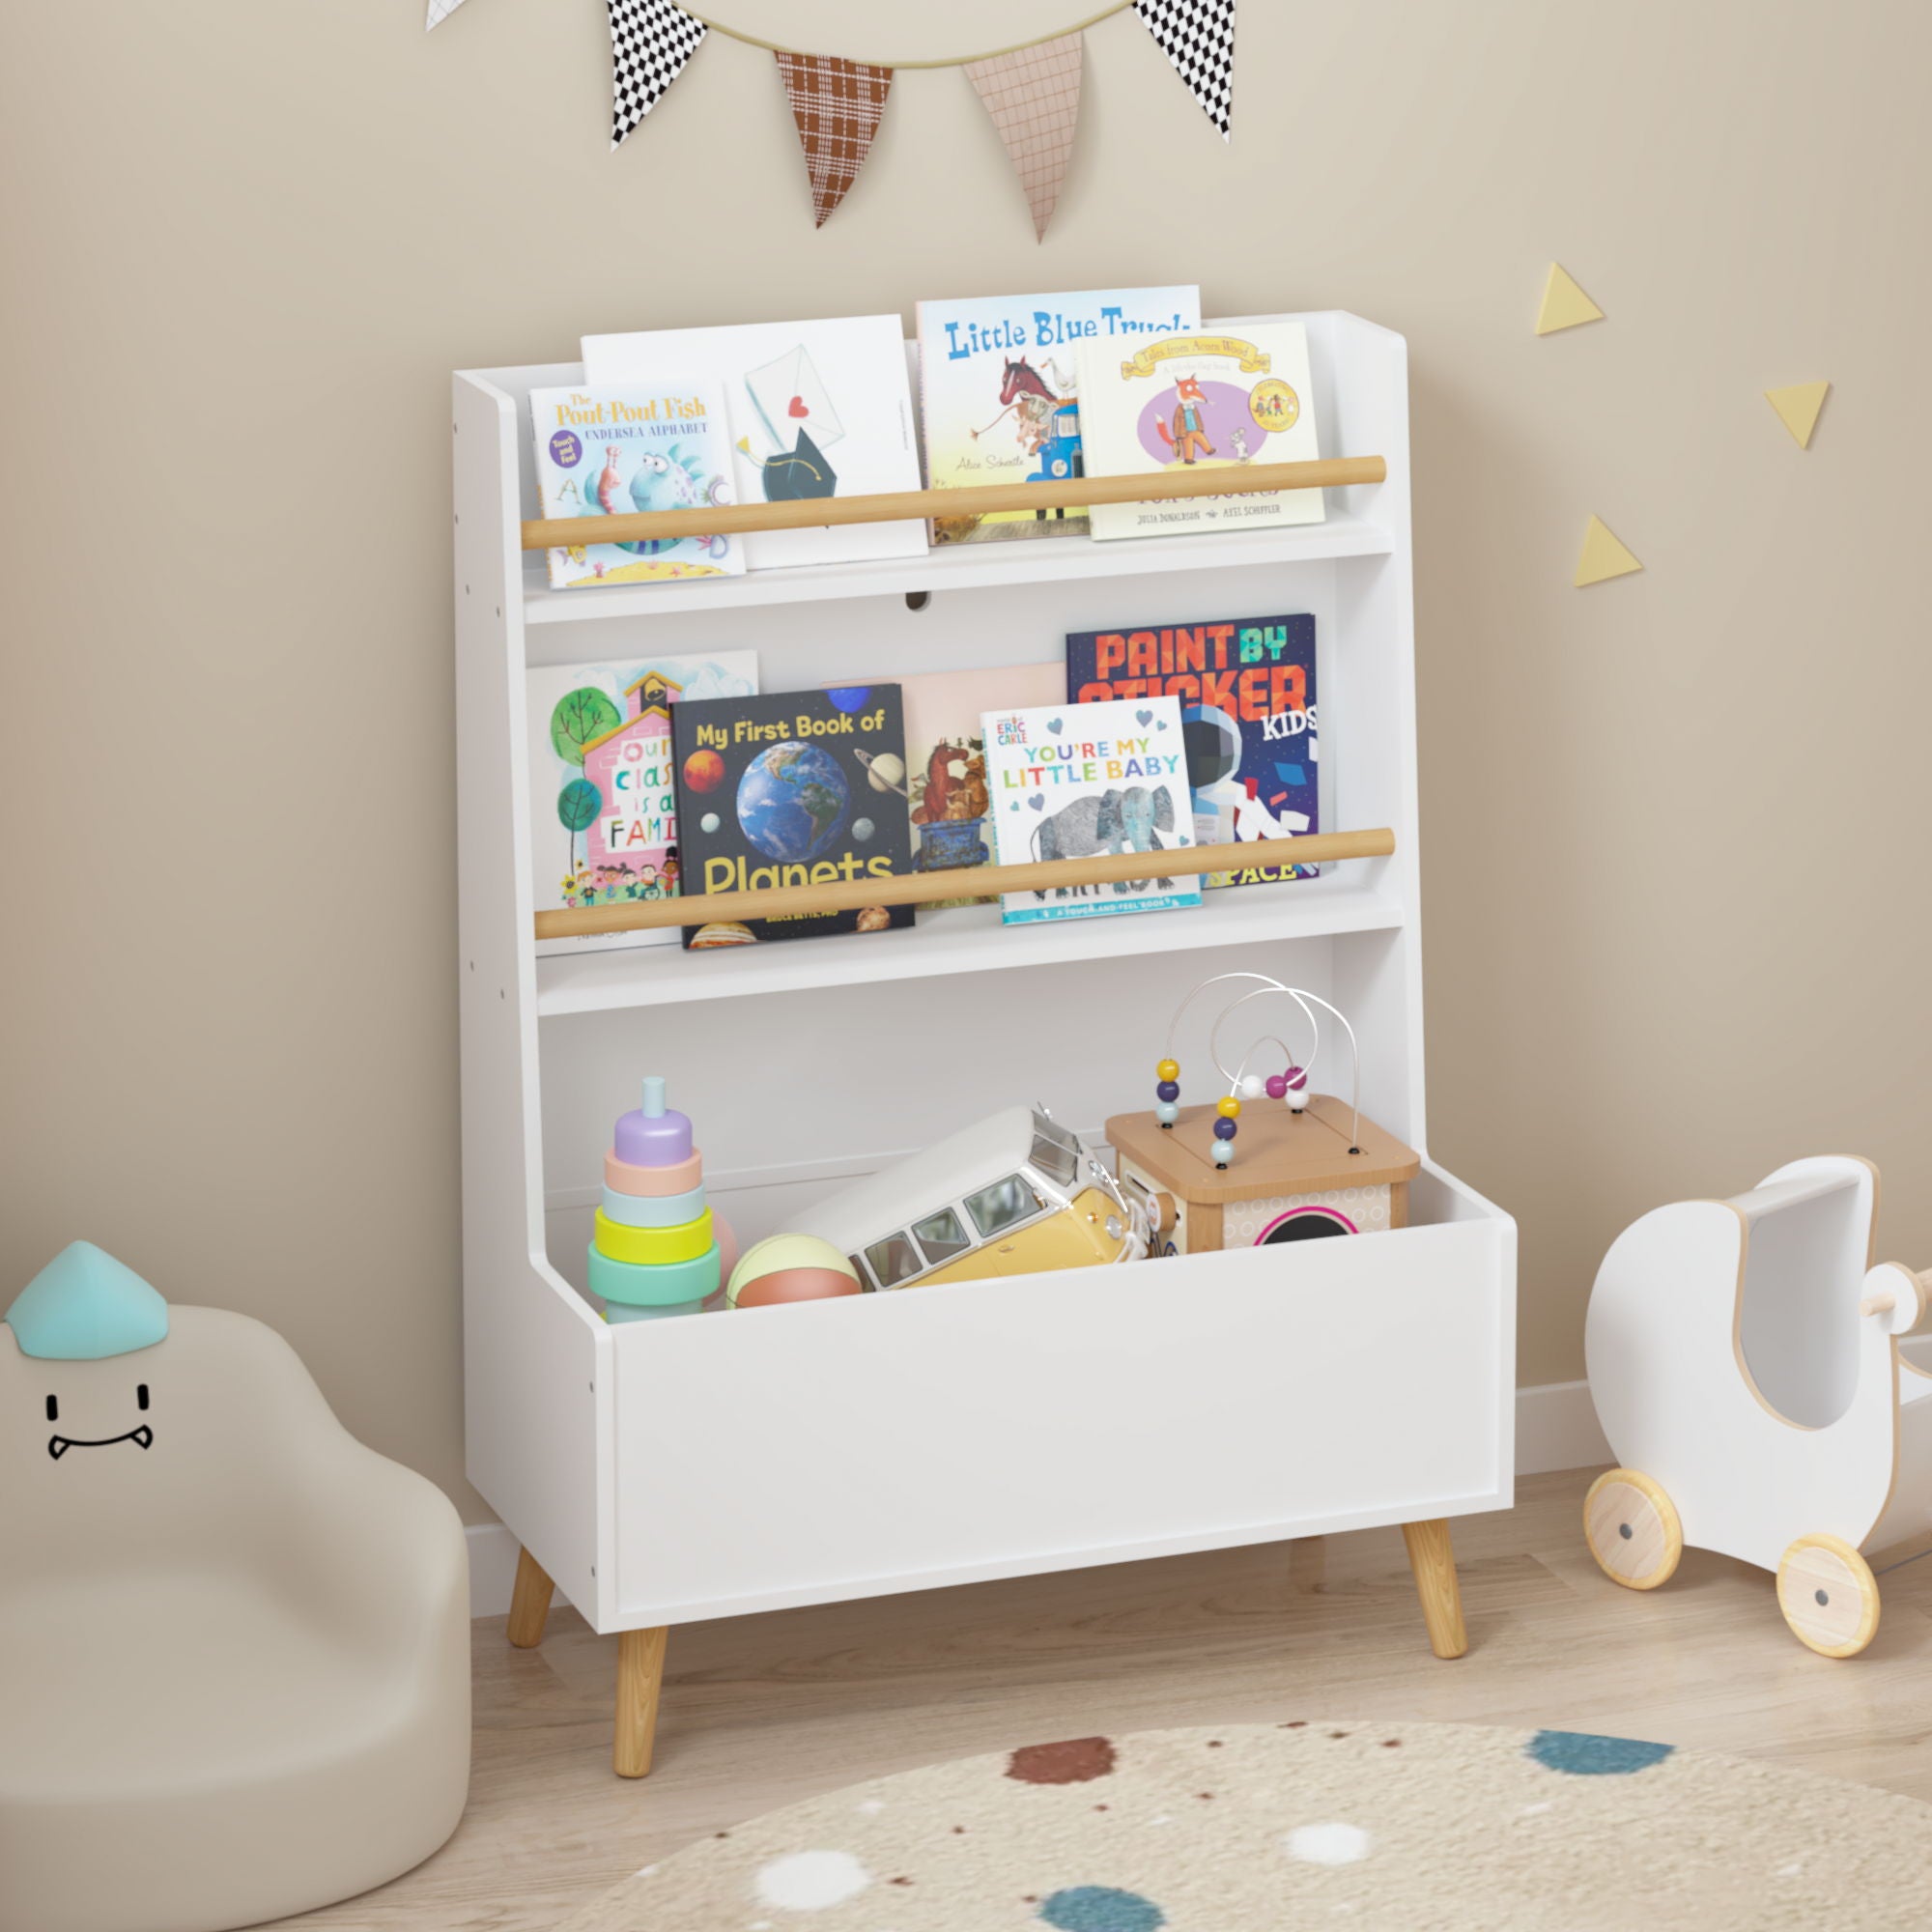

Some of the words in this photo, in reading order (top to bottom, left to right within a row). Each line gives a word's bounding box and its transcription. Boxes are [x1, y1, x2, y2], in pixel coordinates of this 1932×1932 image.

[944, 320, 1026, 360] Little
[1033, 311, 1097, 347] Blue
[554, 399, 661, 426] Pout-Pout
[664, 396, 706, 419] Fish
[570, 393, 591, 406] The
[584, 426, 644, 440] UNDERSEA
[649, 422, 708, 438] ALPHABET
[1095, 624, 1235, 680] PAINT
[1239, 625, 1287, 663] BY
[696, 724, 728, 750] My
[734, 721, 791, 743] First
[796, 712, 854, 738] Book
[861, 709, 886, 731] of
[997, 732, 1028, 745] CARLE
[1260, 704, 1318, 741] KIDS
[1024, 741, 1109, 763] YOU'RE
[1117, 737, 1150, 755] MY
[1003, 762, 1097, 788] LITTLE
[1106, 754, 1179, 780] BABY
[660, 795, 673, 812] a
[704, 852, 894, 895] Planets
